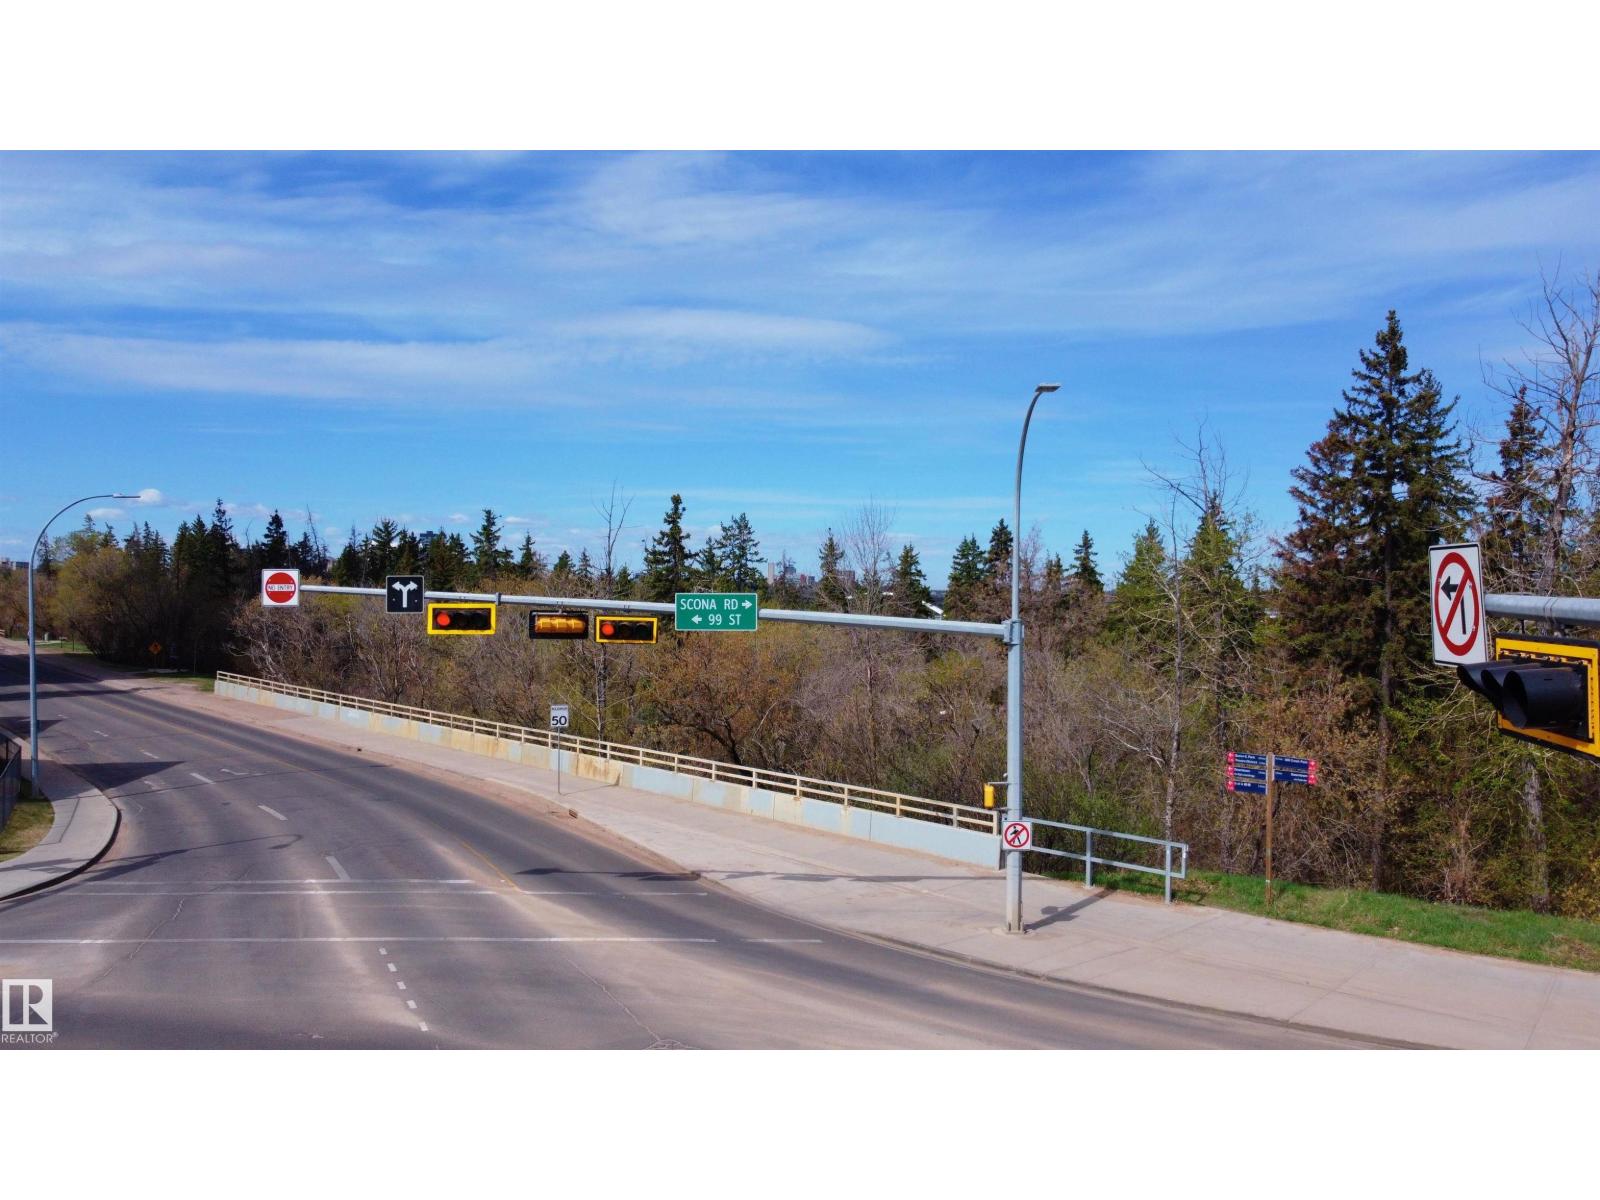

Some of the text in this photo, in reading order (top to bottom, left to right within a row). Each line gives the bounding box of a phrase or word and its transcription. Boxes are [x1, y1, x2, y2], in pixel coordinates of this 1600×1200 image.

[680, 598, 738, 610] SCONA RD
[708, 614, 742, 626] 99 ST
[552, 716, 568, 726] 50
